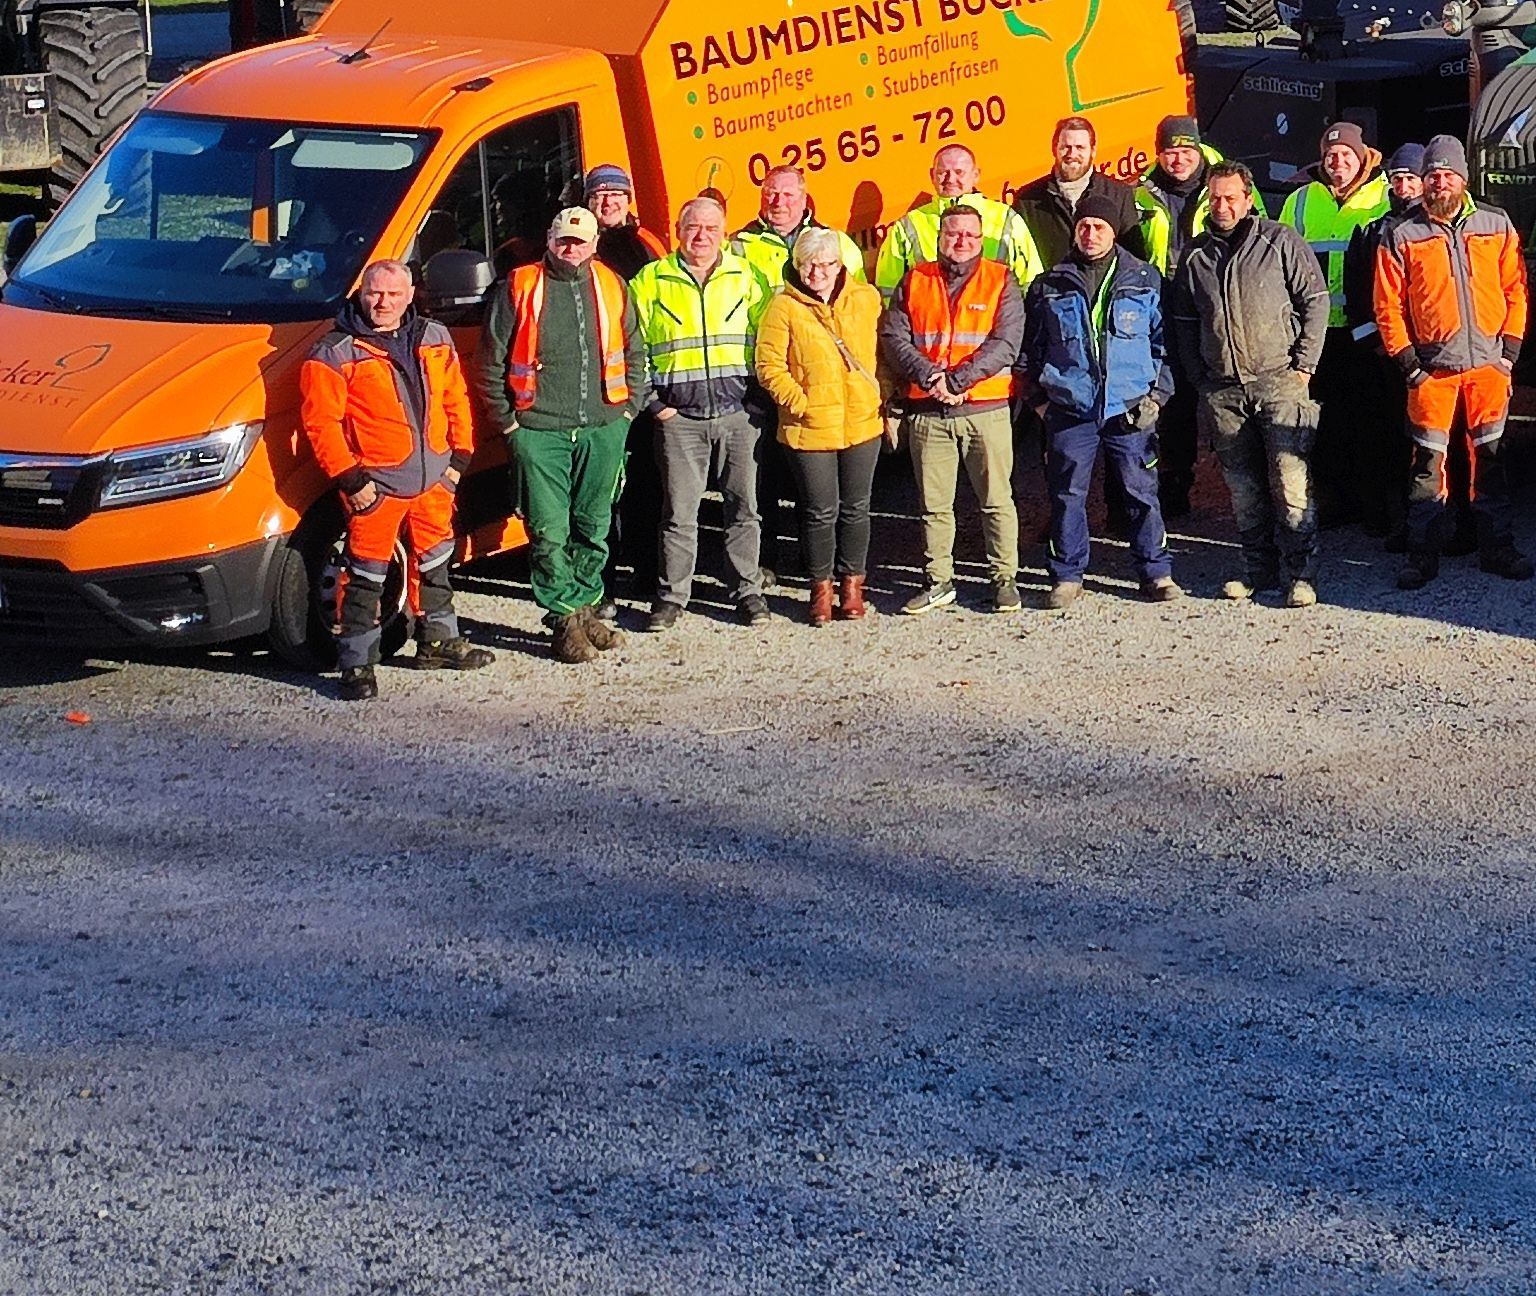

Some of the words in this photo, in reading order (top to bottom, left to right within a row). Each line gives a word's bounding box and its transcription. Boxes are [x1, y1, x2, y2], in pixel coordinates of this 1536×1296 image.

[877, 30, 980, 66] Baumfällung
[707, 67, 815, 105] Baumpflege
[883, 58, 999, 98] Stubbenfräsen
[1243, 75, 1323, 101] schliesing
[713, 90, 853, 139] Baumgutachten
[837, 125, 881, 163] 65
[913, 106, 956, 144] 72
[965, 95, 1006, 132] 00
[1487, 172, 1536, 185] FENDT
